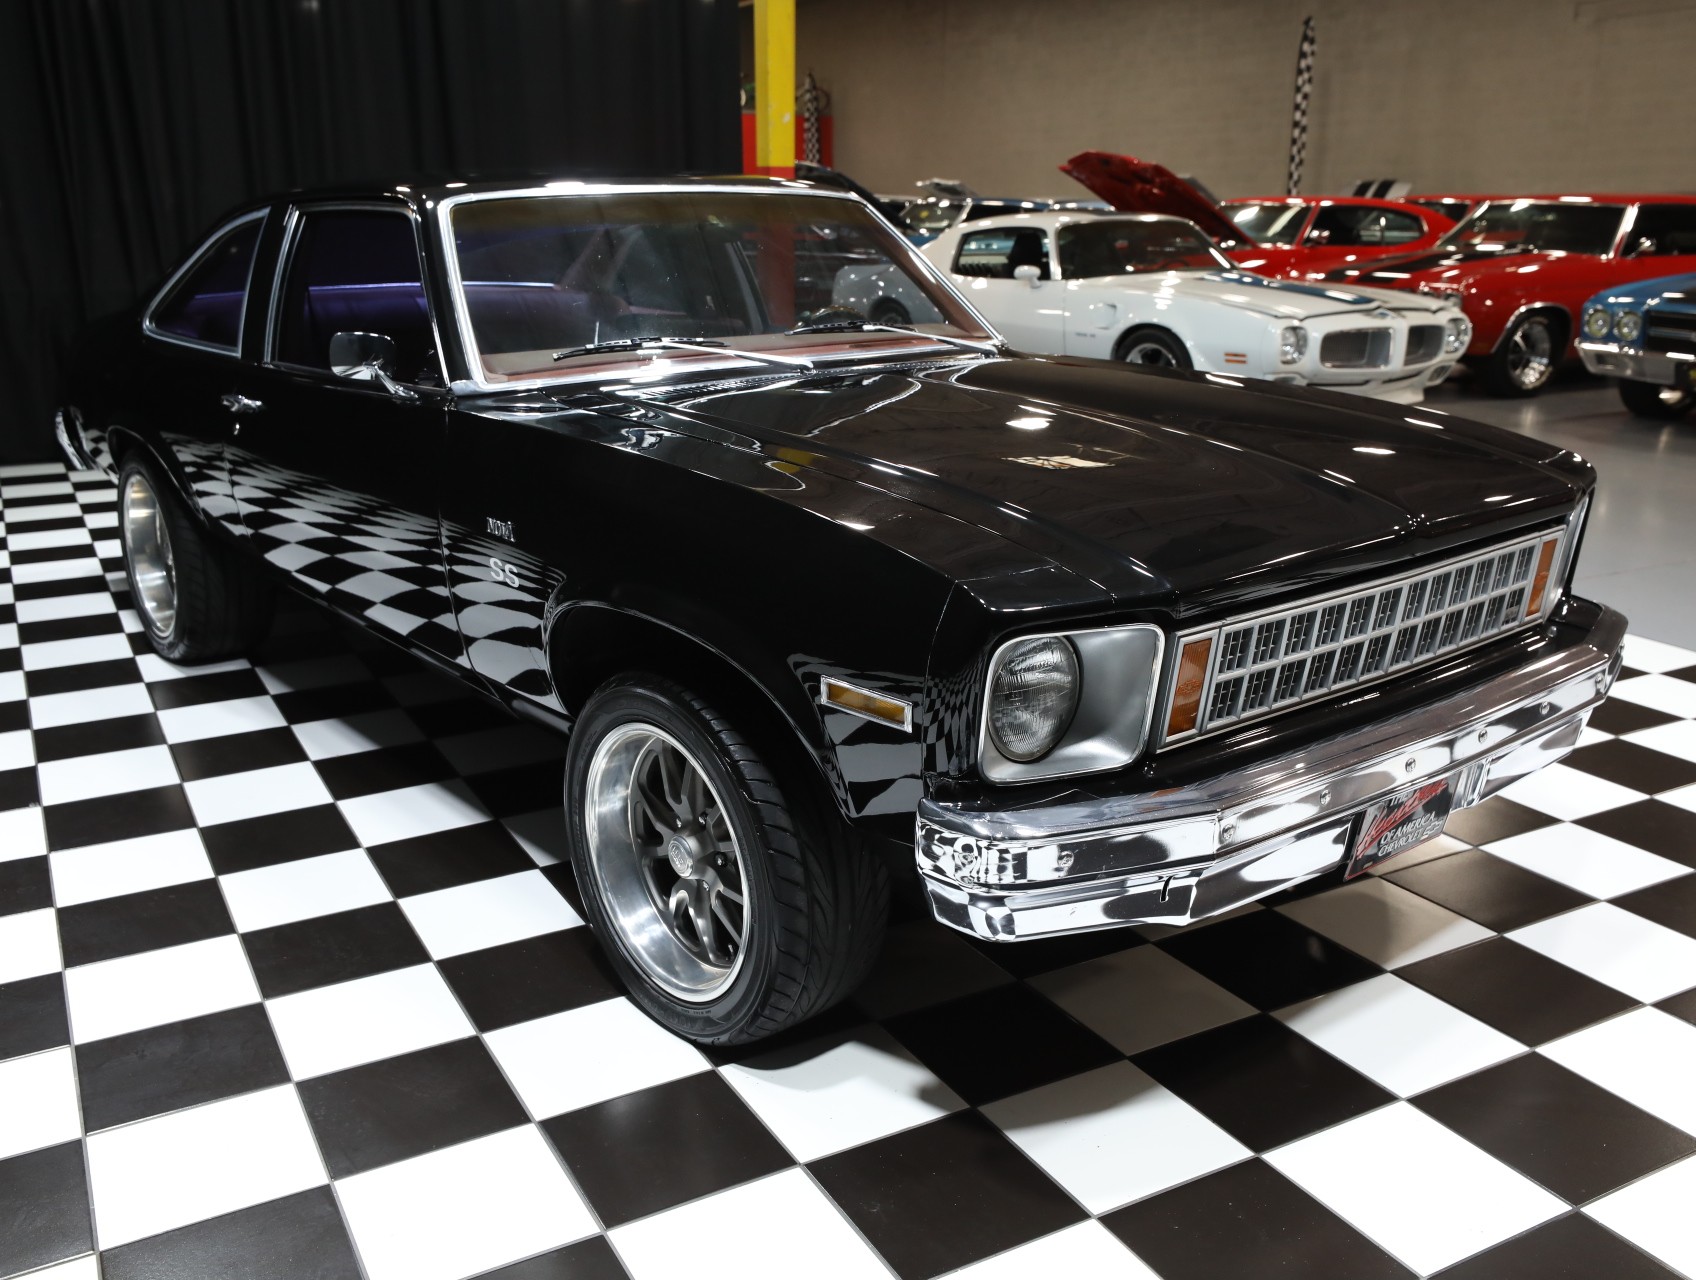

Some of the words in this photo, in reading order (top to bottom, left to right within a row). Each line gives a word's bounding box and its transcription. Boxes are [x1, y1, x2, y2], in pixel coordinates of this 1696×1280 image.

[489, 557, 520, 588] SS
[1378, 827, 1423, 857] CHEVROLET
[1381, 829, 1396, 844] OF
[1394, 811, 1436, 838] AMERICA
